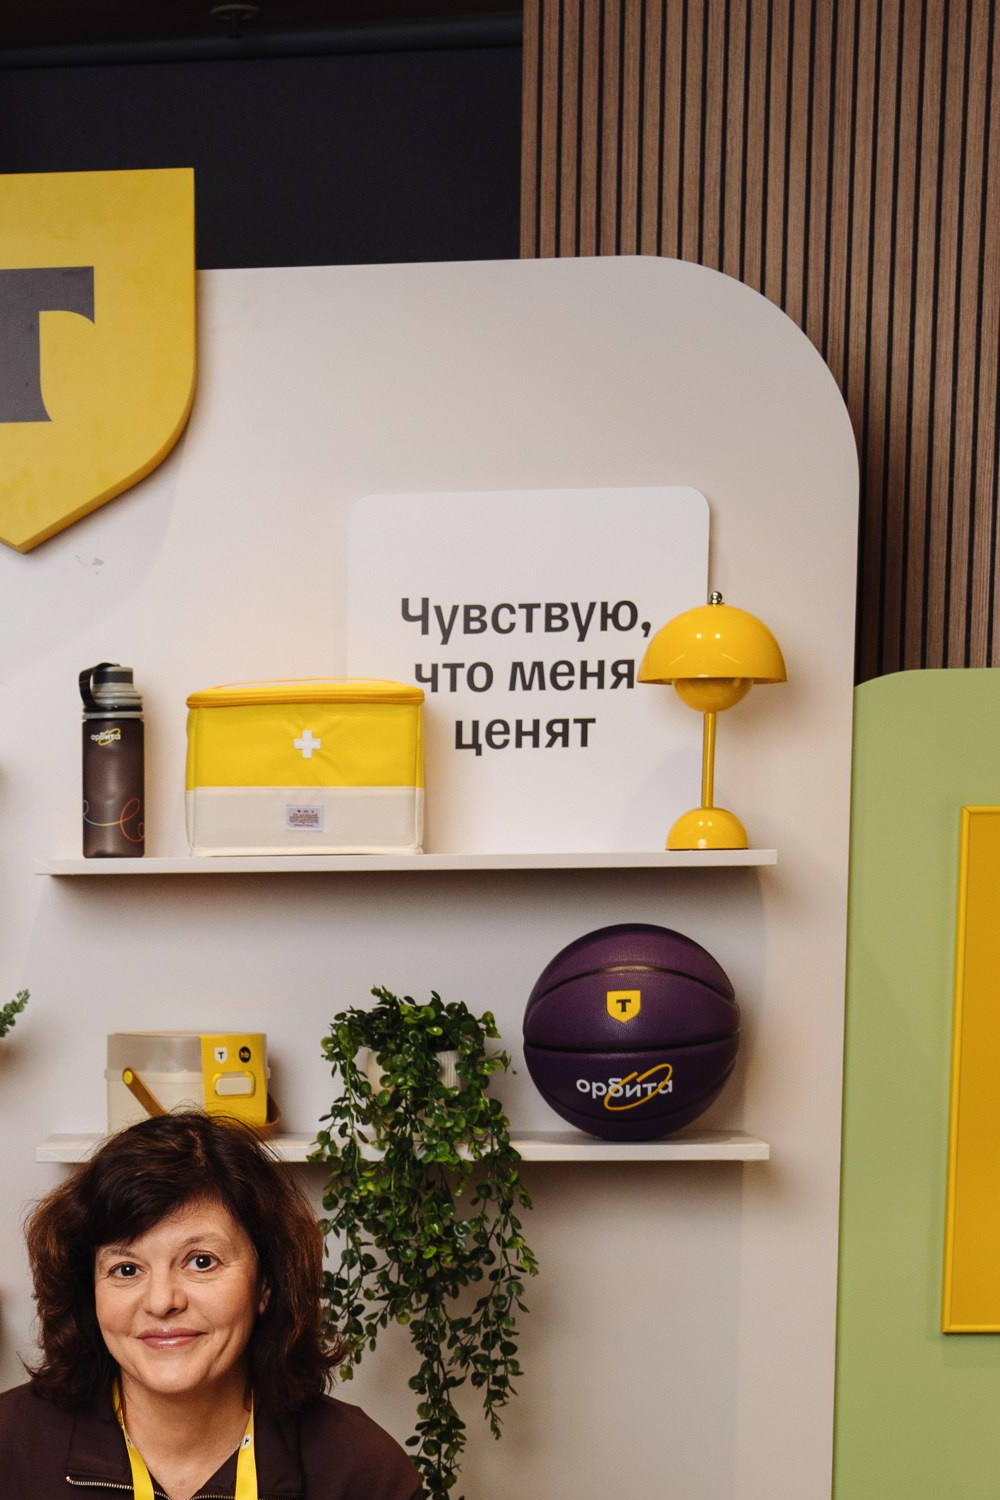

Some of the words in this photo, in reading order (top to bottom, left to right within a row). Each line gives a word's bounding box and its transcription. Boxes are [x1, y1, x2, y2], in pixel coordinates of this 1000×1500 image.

[401, 597, 652, 645] Чувствую,
[414, 661, 494, 693] что
[508, 659, 635, 692] меня
[455, 717, 597, 757] ценят
[616, 999, 632, 1013] Т
[576, 1077, 673, 1100] орбита
